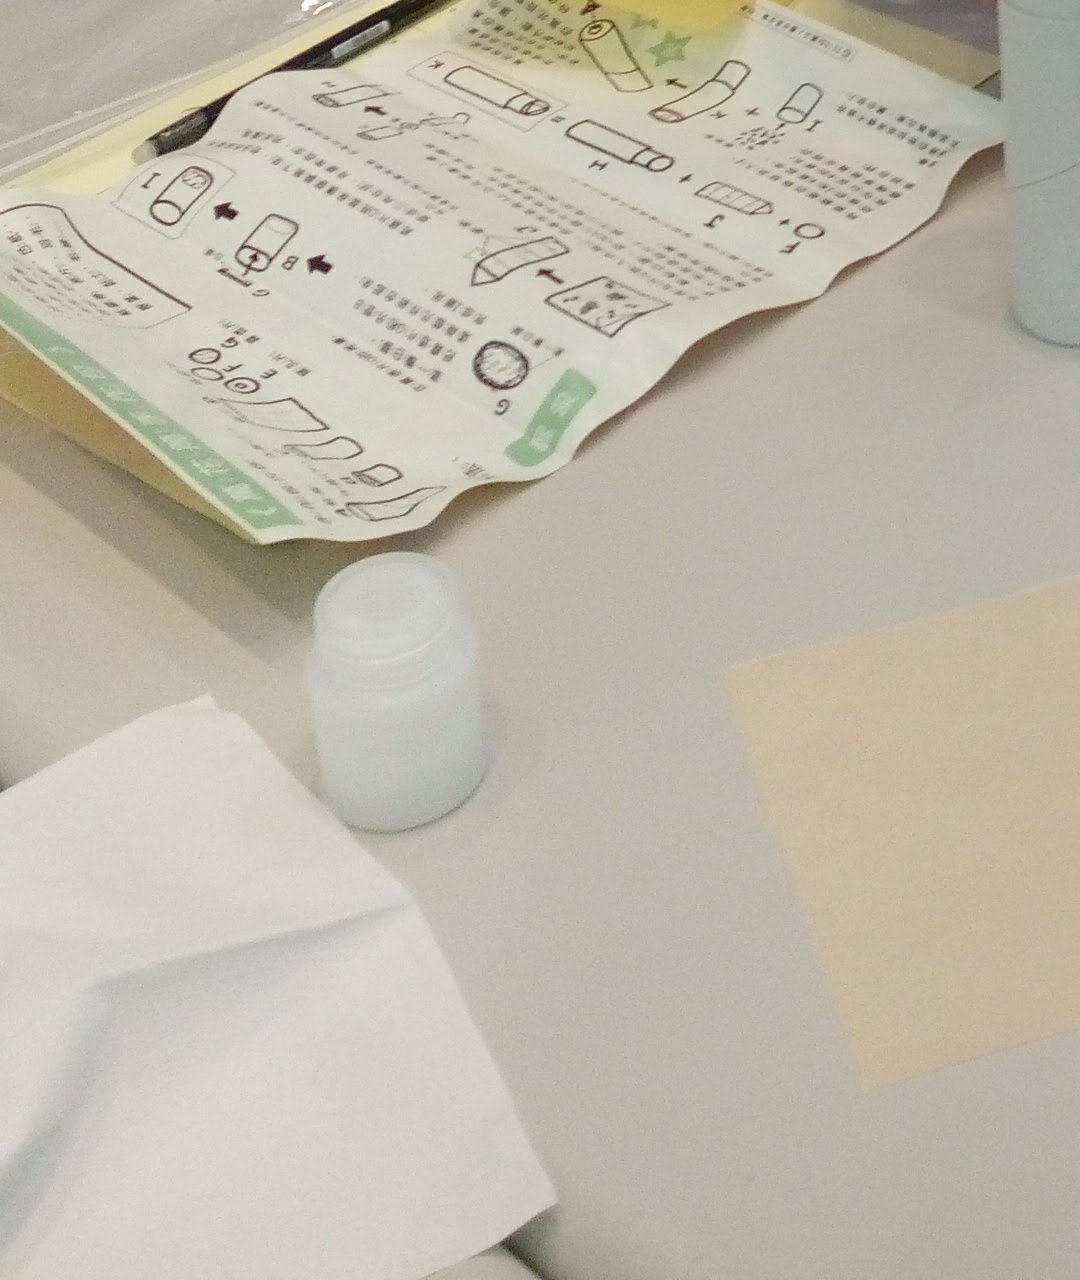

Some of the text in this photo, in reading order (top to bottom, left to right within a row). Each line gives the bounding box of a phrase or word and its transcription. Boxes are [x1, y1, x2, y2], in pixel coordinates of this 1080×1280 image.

[141, 172, 162, 190] I
[281, 255, 299, 271] B
[220, 336, 240, 349] G
[493, 398, 511, 416] G
